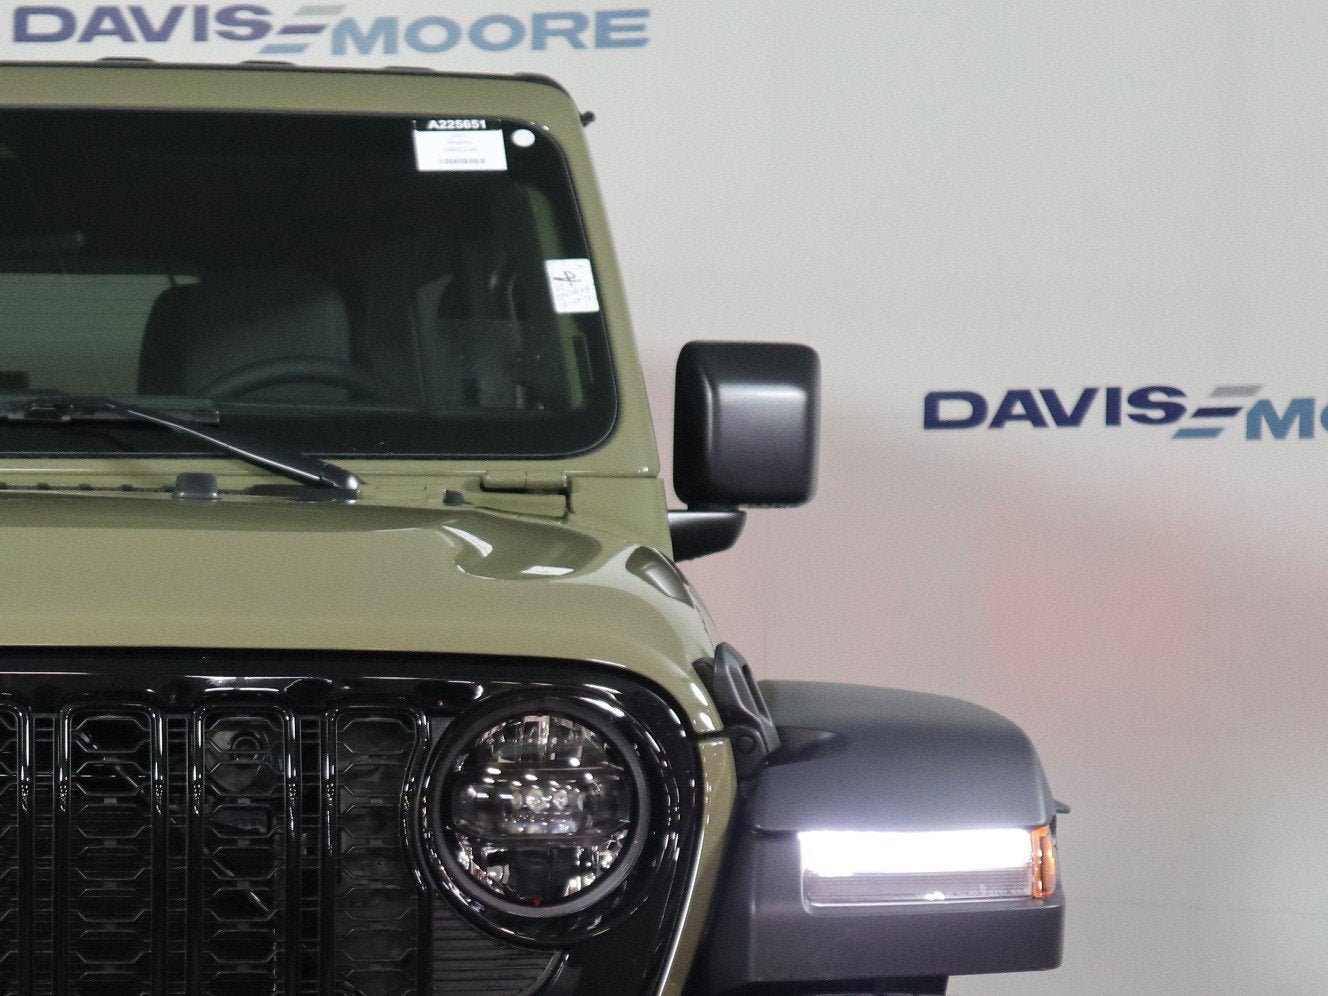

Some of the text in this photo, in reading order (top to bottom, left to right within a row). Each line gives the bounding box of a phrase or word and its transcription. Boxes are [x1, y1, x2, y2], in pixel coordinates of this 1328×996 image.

[12, 4, 650, 56] DAVIS MOORE
[427, 119, 487, 130] A225651
[924, 386, 1188, 430] DAVIS
